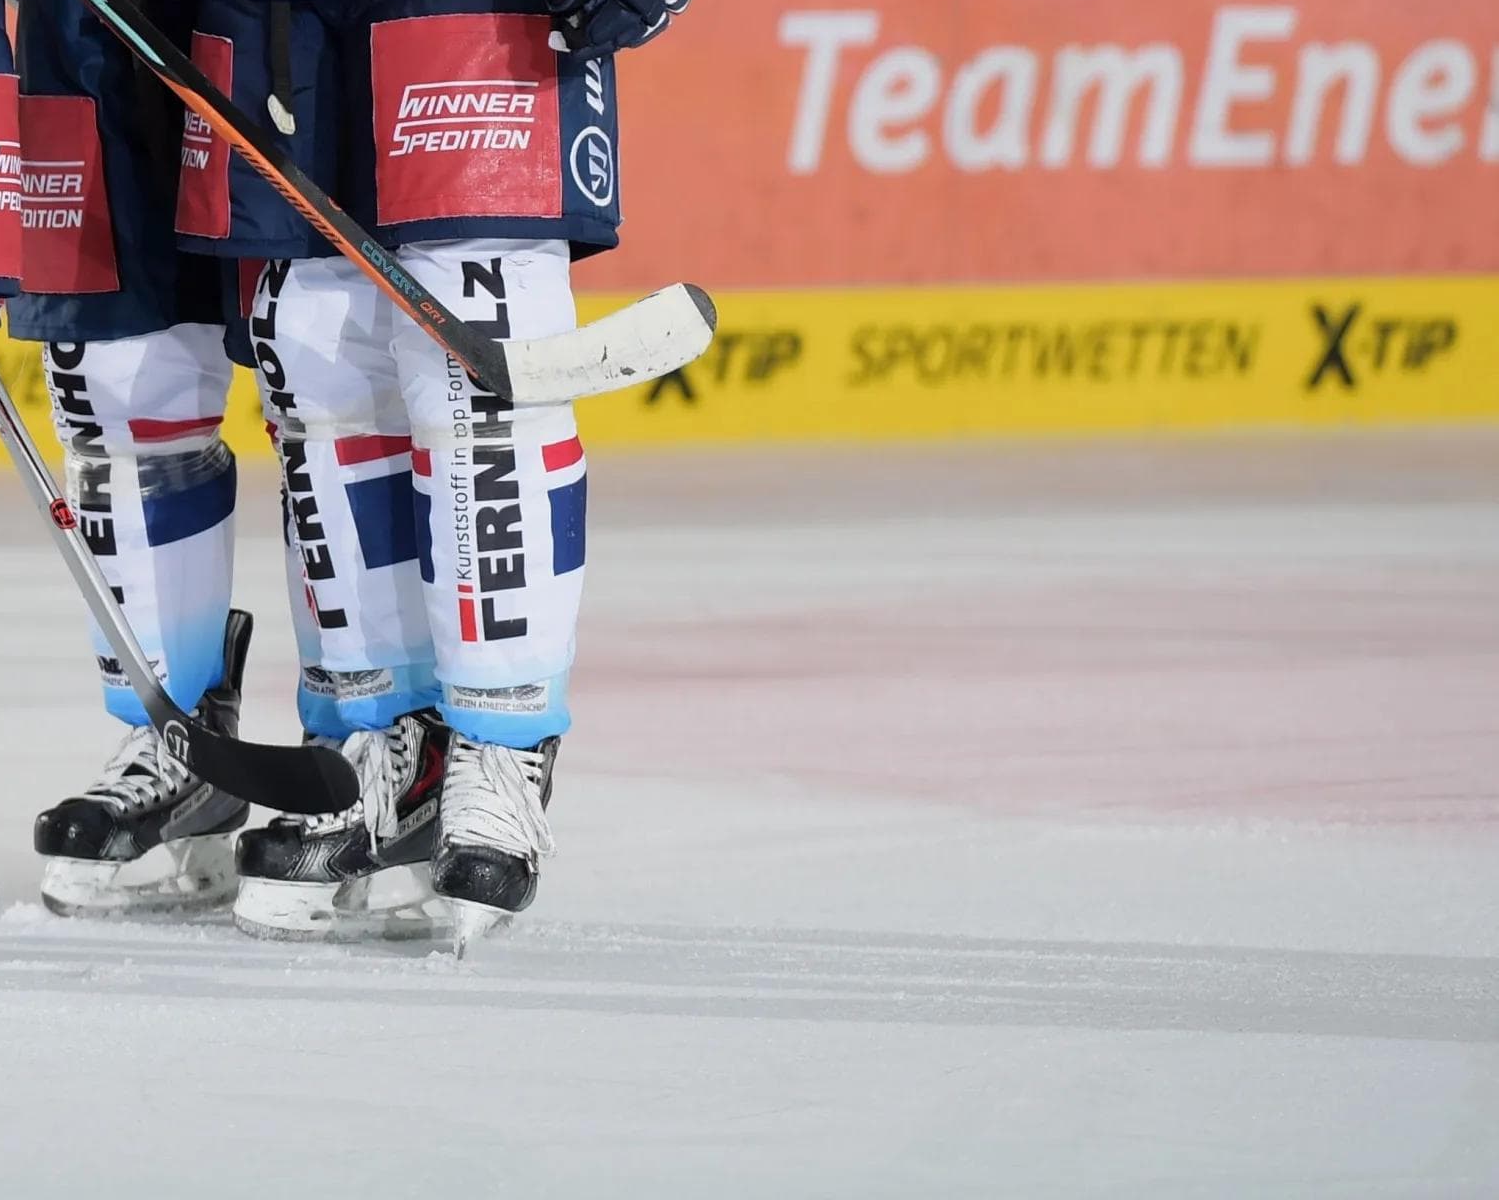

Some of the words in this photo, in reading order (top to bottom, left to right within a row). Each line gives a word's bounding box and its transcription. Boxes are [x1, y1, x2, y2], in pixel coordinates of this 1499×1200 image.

[398, 80, 538, 118] WINNER
[389, 117, 534, 156] SPEDITION
[361, 240, 422, 300] COVERT
[419, 301, 447, 324] QR1
[845, 320, 1263, 390] SPORTWETTEN
[452, 407, 471, 442] top
[451, 447, 468, 467] in
[462, 256, 529, 643] FERNHLZ
[455, 473, 473, 581] Kunststoff
